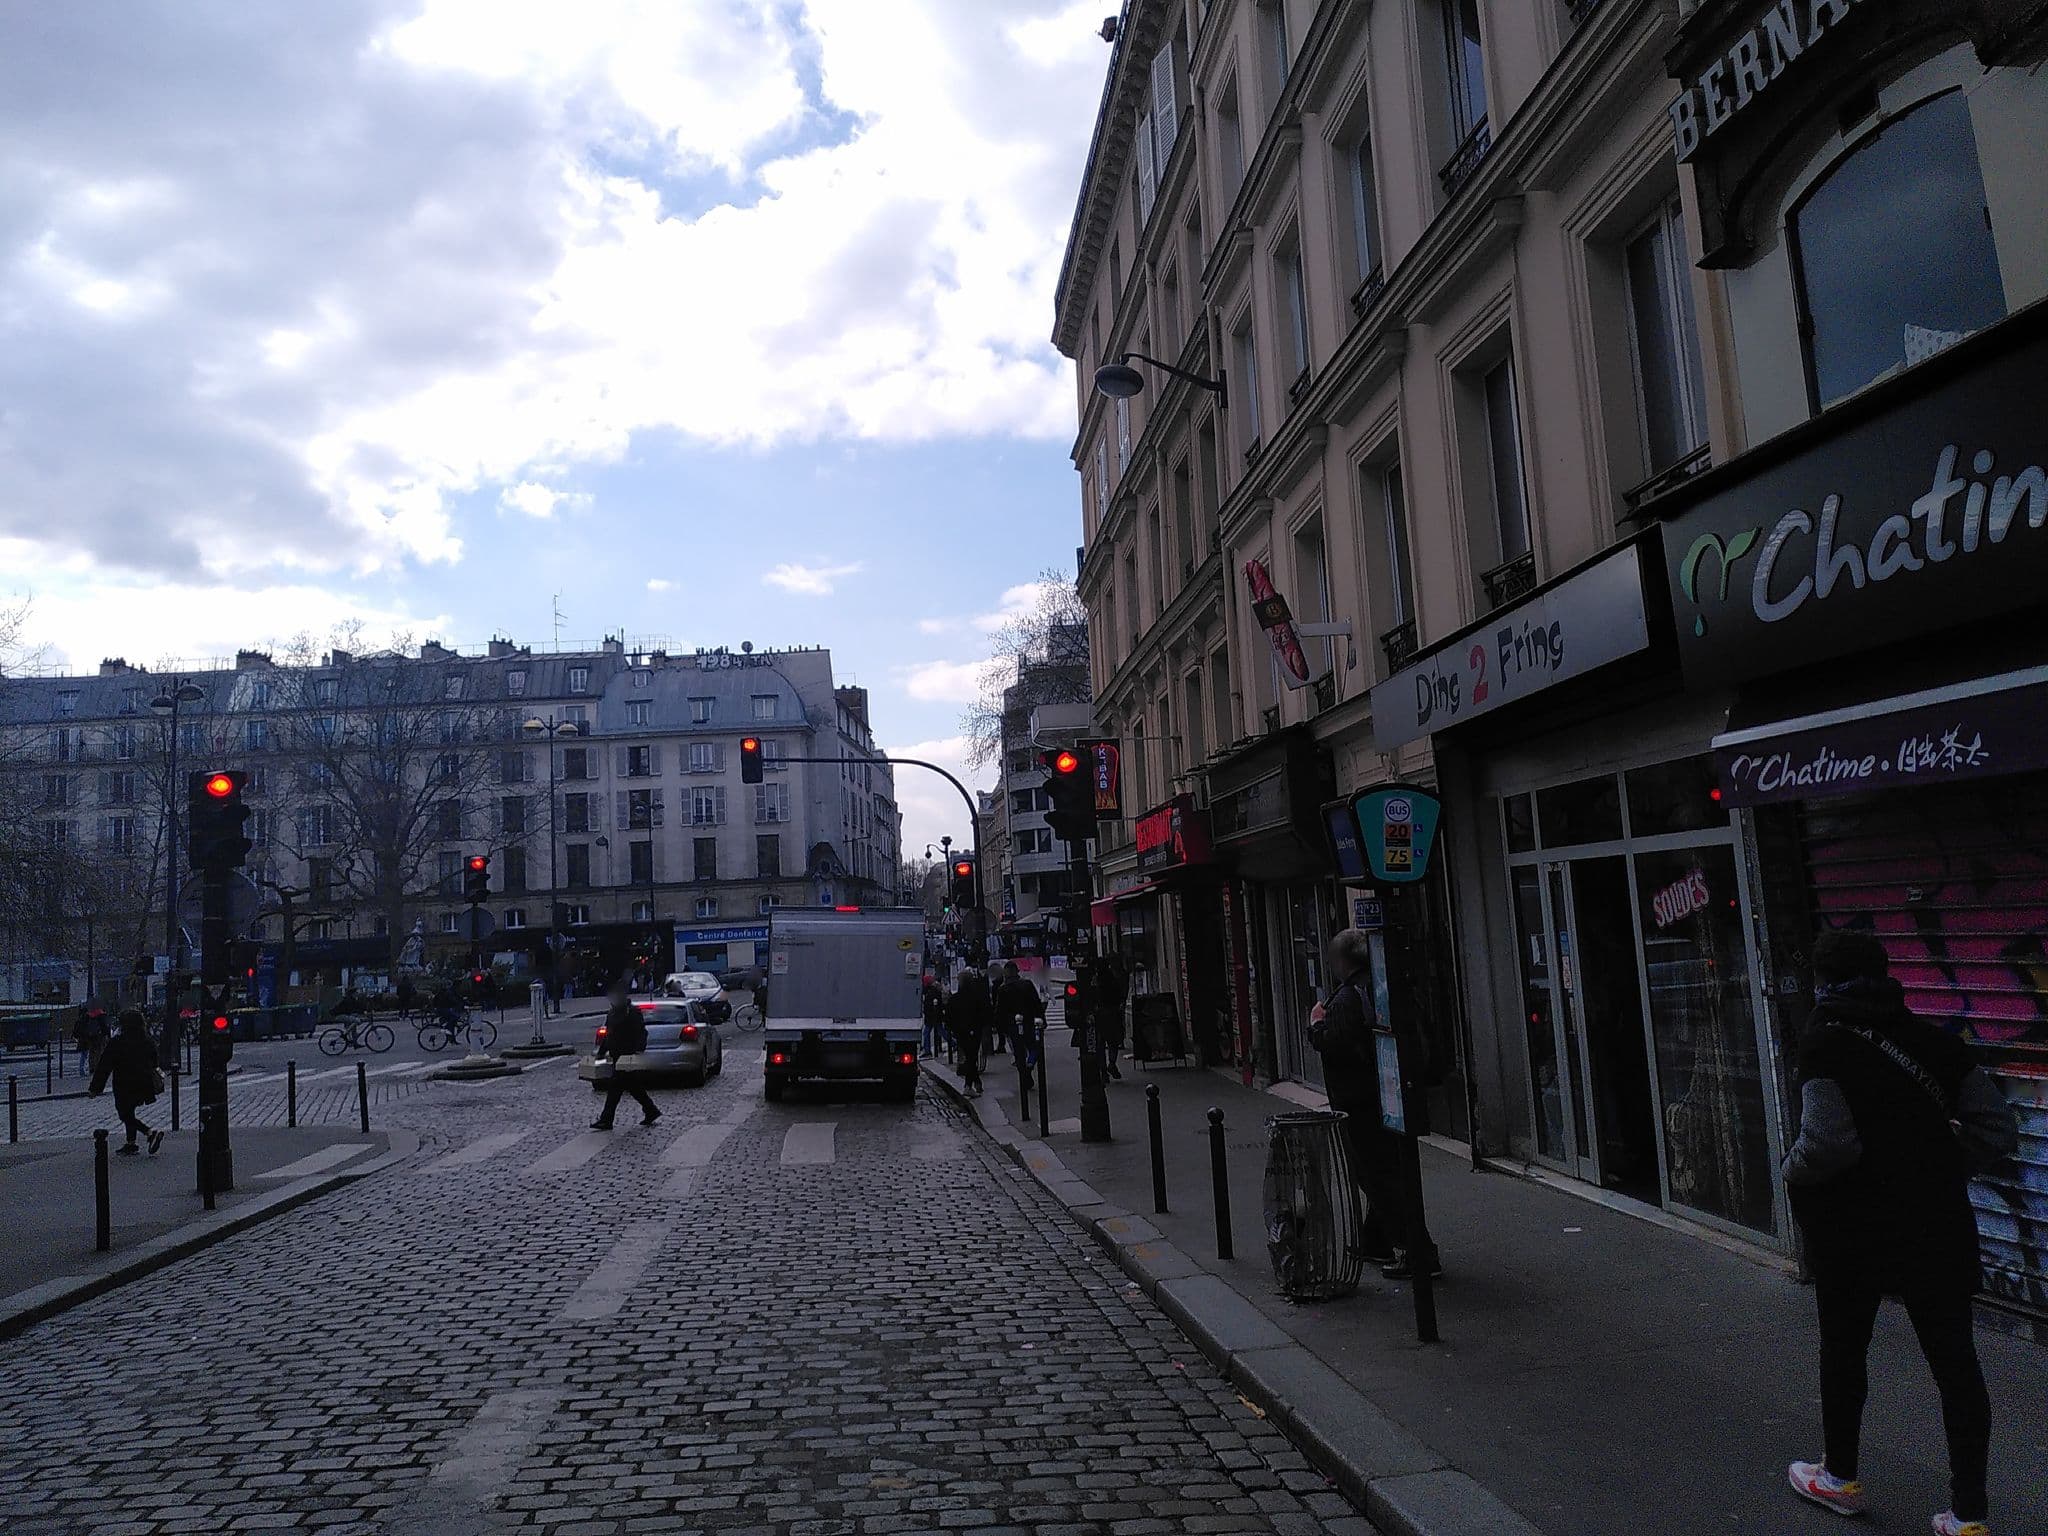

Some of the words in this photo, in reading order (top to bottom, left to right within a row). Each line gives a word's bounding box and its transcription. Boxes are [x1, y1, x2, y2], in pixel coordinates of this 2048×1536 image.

[1668, 0, 1864, 163] BERNA
[1416, 667, 1460, 726] Ding
[1469, 644, 1489, 705] 2
[1497, 619, 1564, 691] Fring
[1757, 746, 1875, 792] Chatime
[1389, 805, 1407, 815] BUS
[1389, 824, 1408, 838] 20
[1388, 850, 1408, 863] 75
[1653, 873, 1710, 929] SOLDES
[697, 931, 725, 940] Centre
[1880, 1039, 1919, 1075] BIMBA
